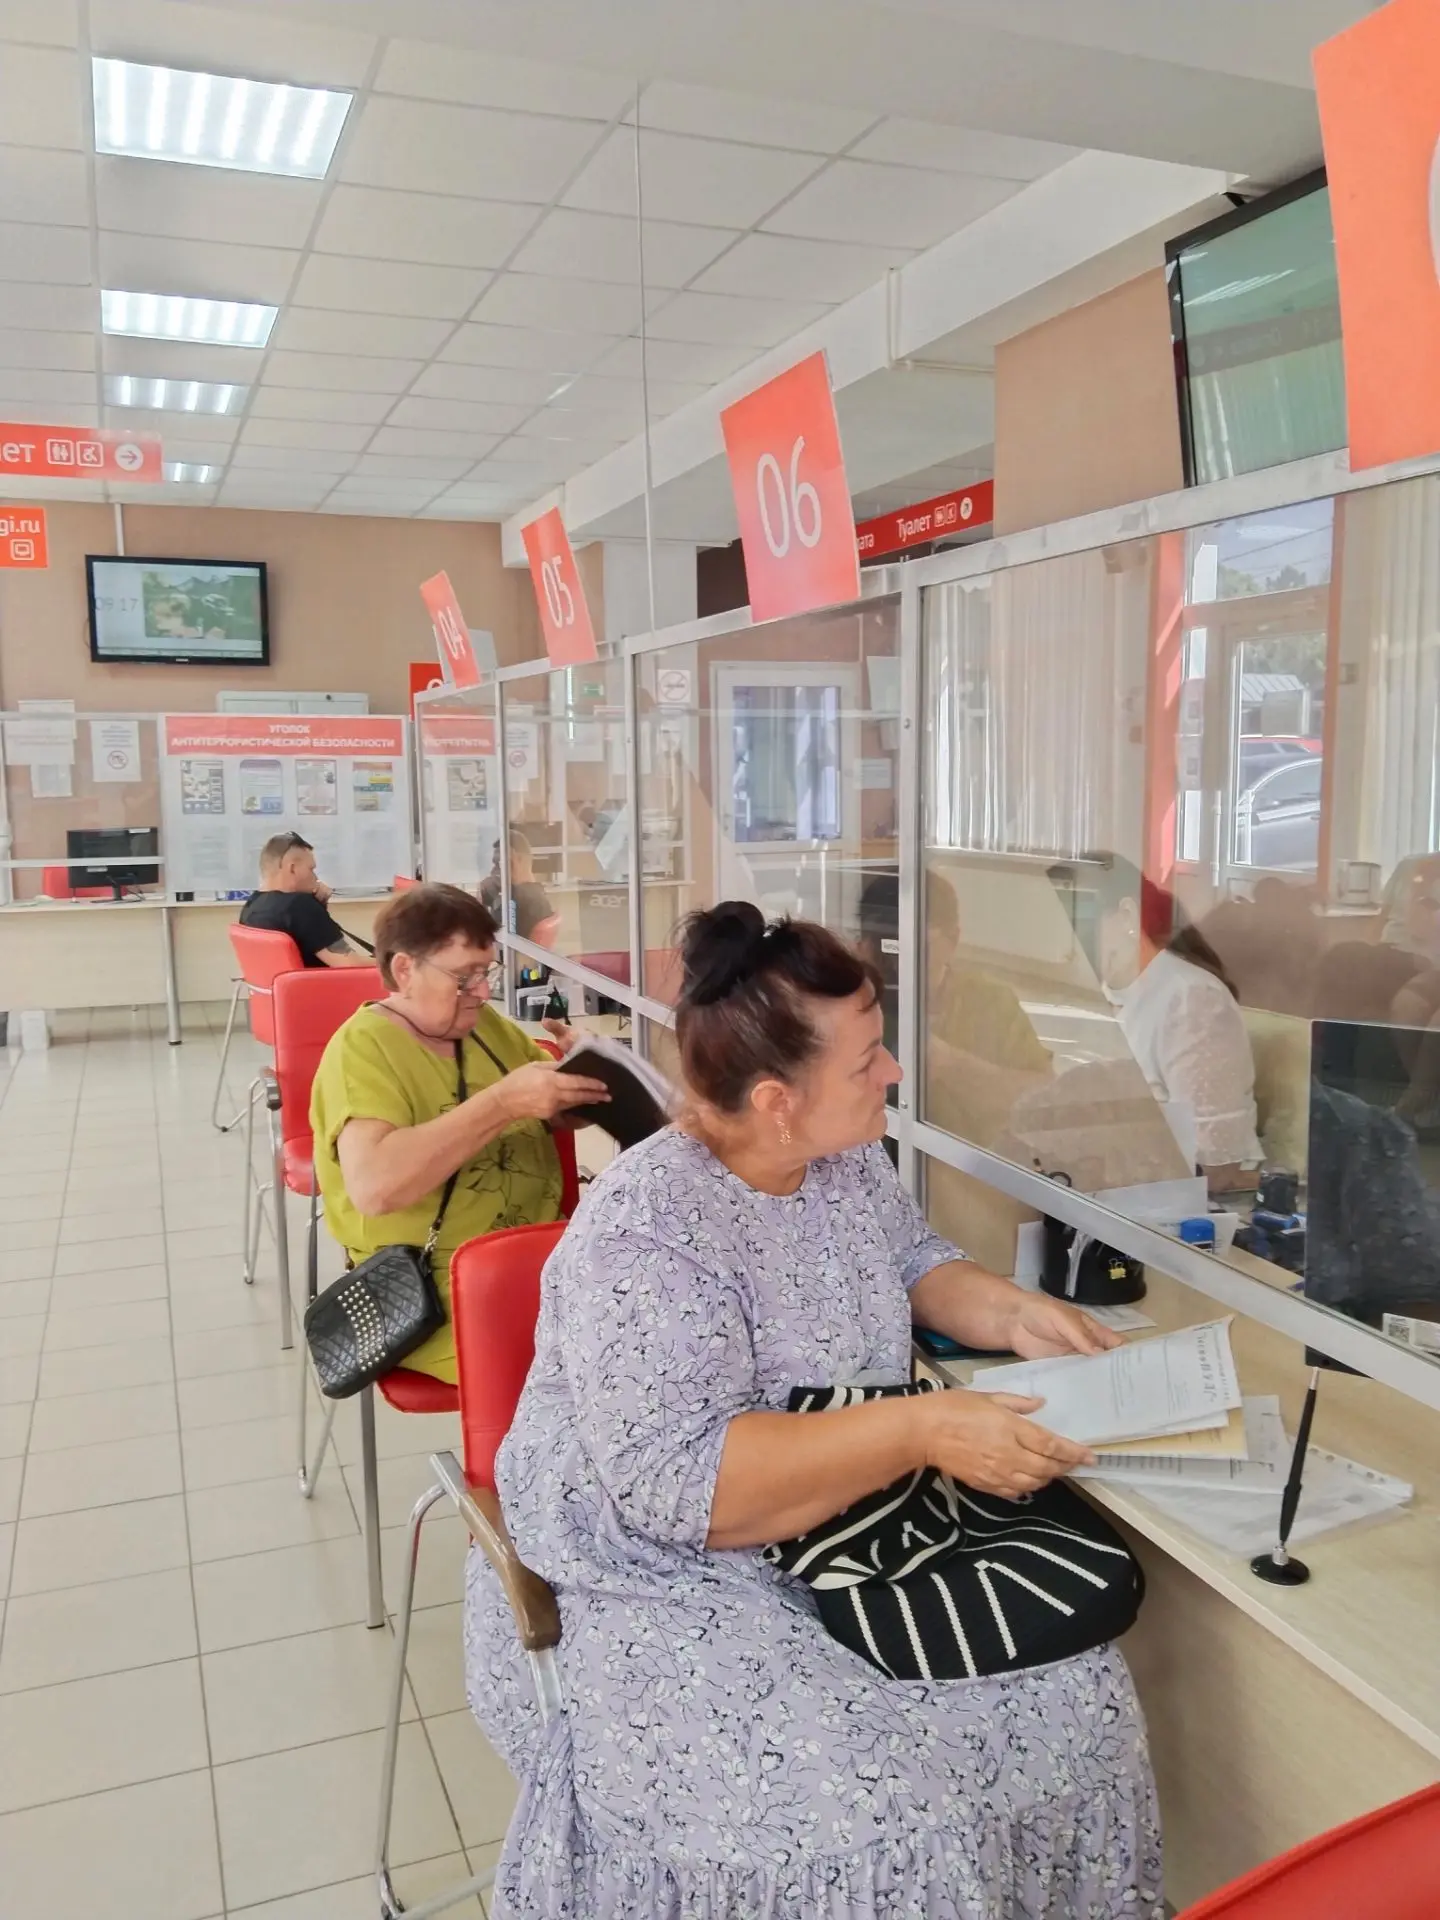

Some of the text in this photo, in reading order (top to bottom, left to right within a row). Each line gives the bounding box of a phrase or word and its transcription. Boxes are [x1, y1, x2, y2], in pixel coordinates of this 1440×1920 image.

[0, 441, 36, 463] ет
[757, 436, 822, 558] 06
[897, 514, 932, 542] Туалет
[541, 555, 574, 628] 05
[437, 606, 466, 660] 04
[268, 724, 310, 734] УГОЛОК
[171, 736, 395, 748] АНТИТЕРРОРИСТИЧЕСКОЙ БЕЗОПАСНОСТИ
[590, 894, 628, 908] acer
